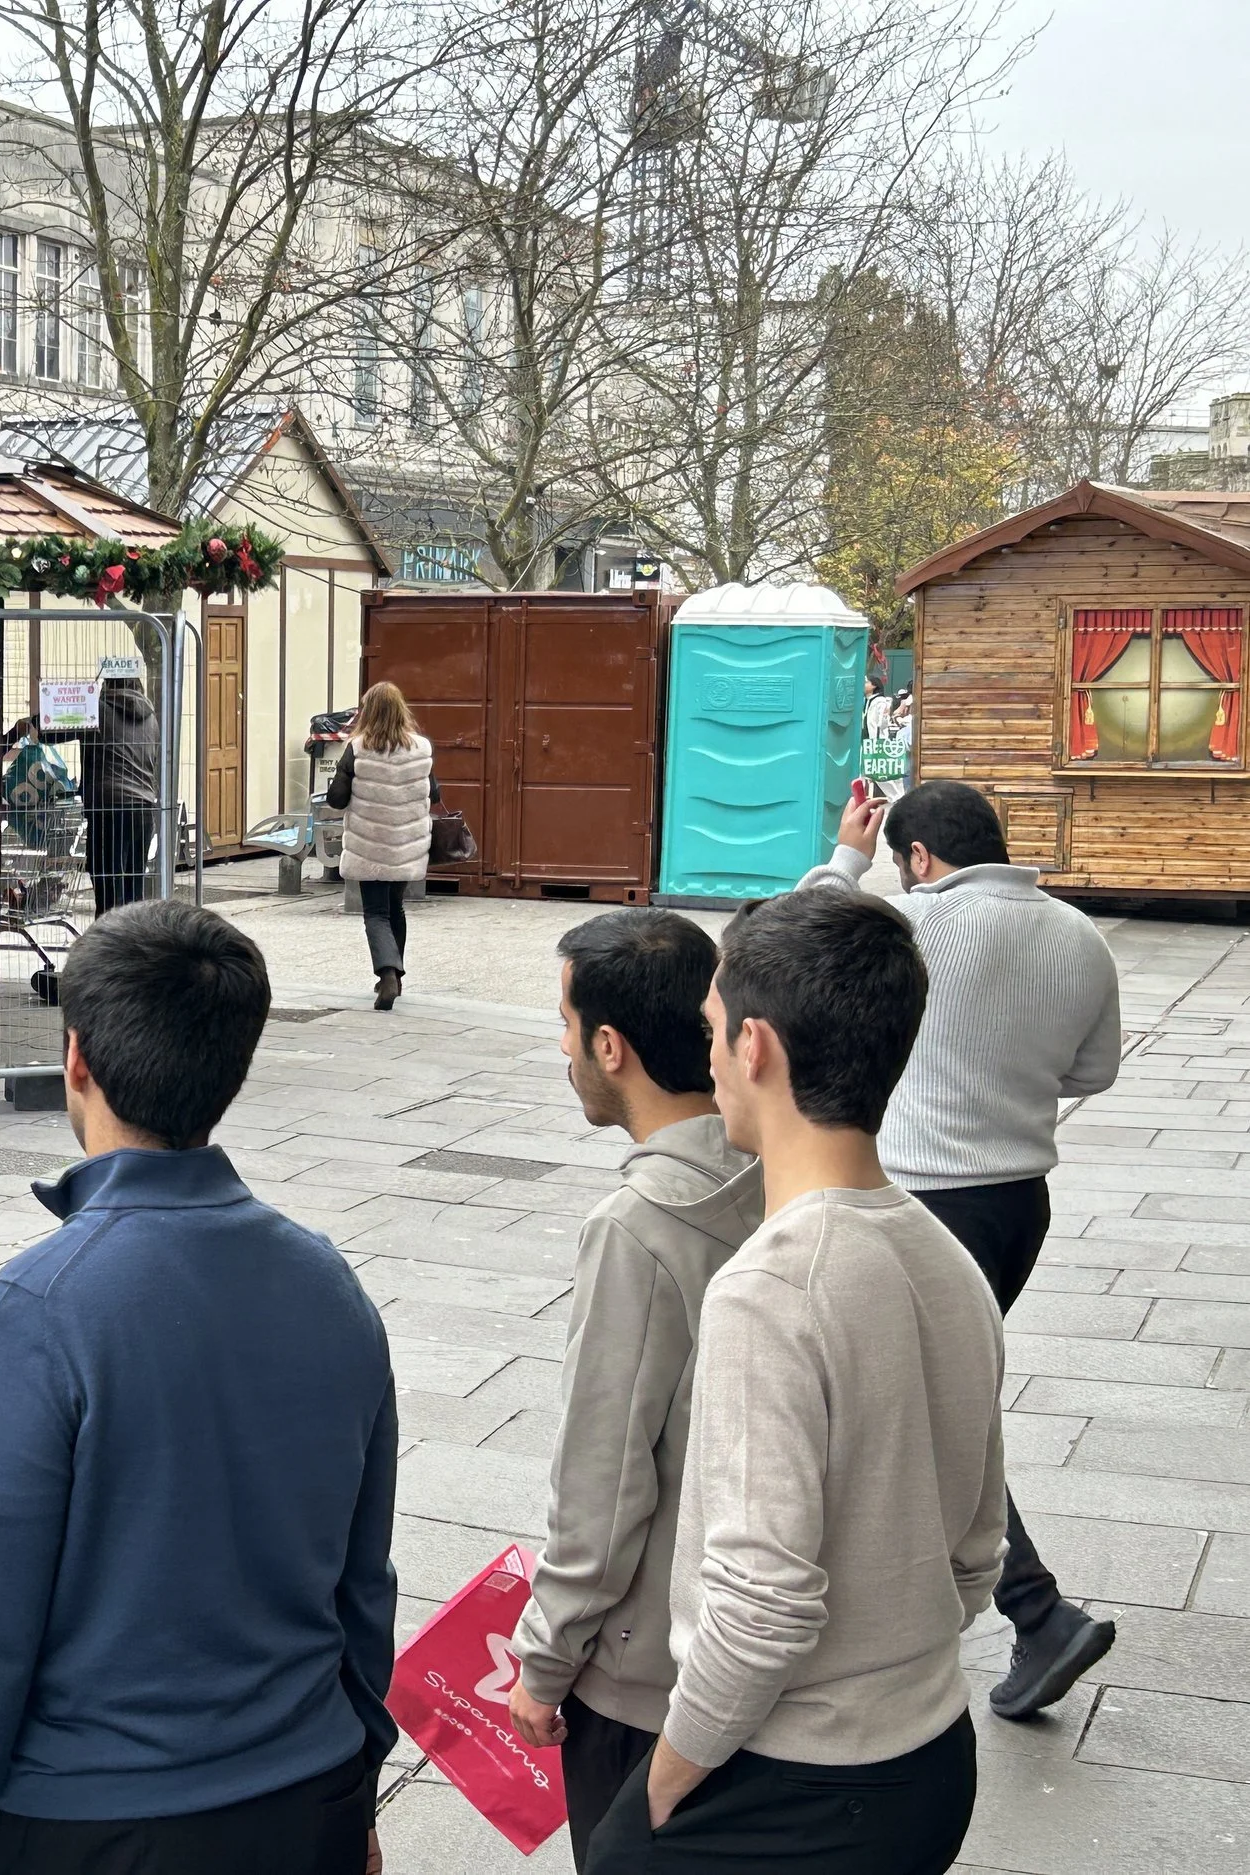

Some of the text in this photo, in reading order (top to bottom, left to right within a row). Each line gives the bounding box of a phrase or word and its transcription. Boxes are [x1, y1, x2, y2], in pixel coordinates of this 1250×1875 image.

[403, 545, 481, 580] PRIMARK
[57, 686, 81, 695] STAFF
[863, 758, 905, 775] EARTH
[424, 1670, 550, 1790] Superdrug
